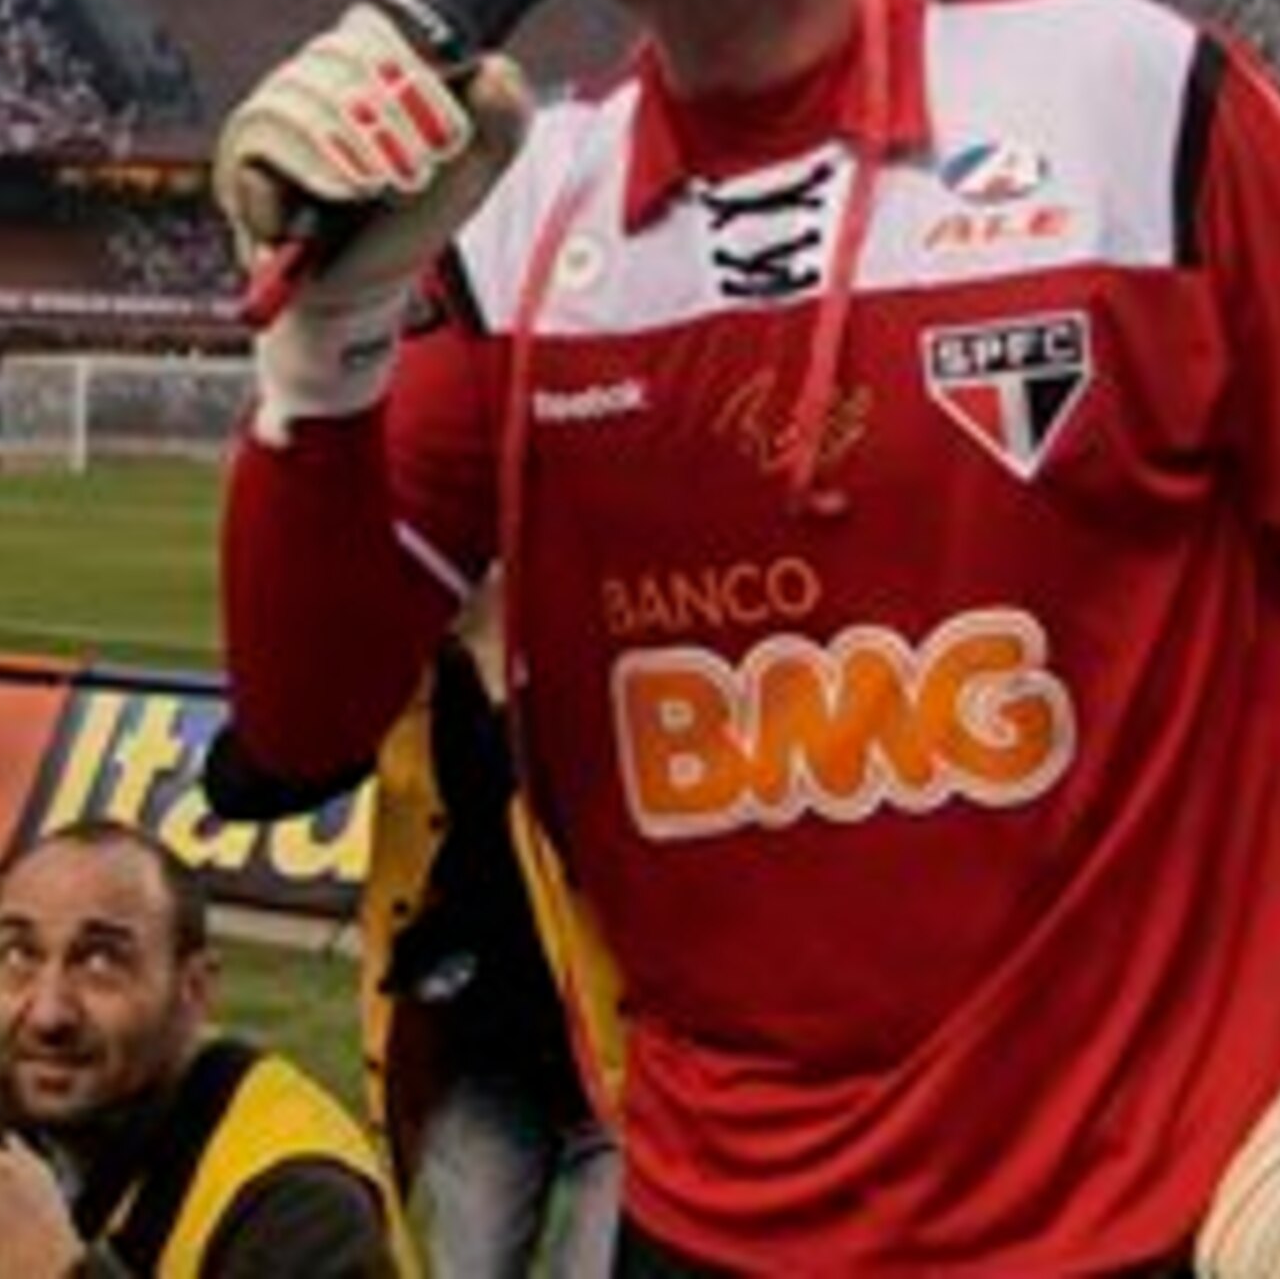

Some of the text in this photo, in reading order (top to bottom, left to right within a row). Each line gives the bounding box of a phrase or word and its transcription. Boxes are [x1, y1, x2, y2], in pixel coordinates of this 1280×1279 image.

[938, 324, 1076, 374] SPFC
[533, 378, 646, 420] Reebok
[604, 556, 821, 634] BANCO
[612, 605, 1077, 840] BMG
